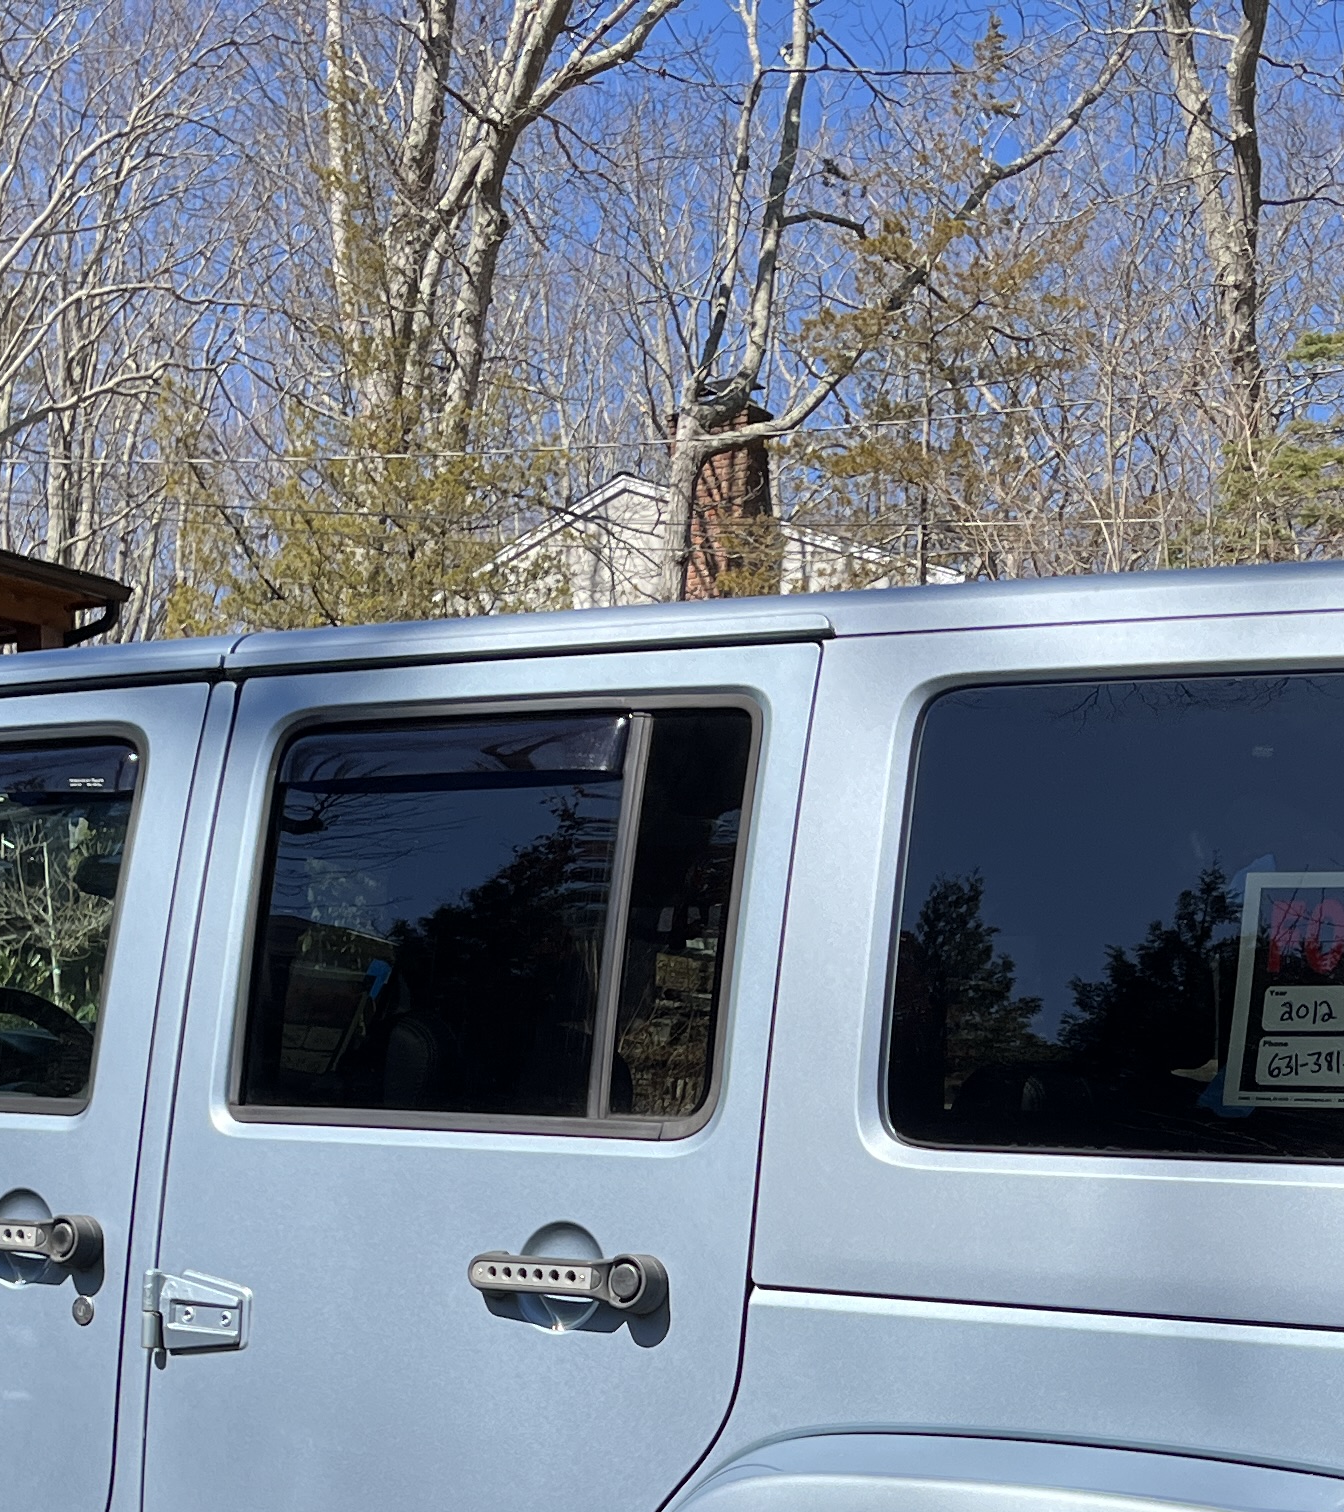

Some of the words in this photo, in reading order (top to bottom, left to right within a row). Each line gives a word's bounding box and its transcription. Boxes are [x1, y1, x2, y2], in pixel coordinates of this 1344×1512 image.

[1269, 989, 1288, 997] Year
[1280, 1000, 1338, 1025] 2012
[1262, 1039, 1289, 1048] Phone
